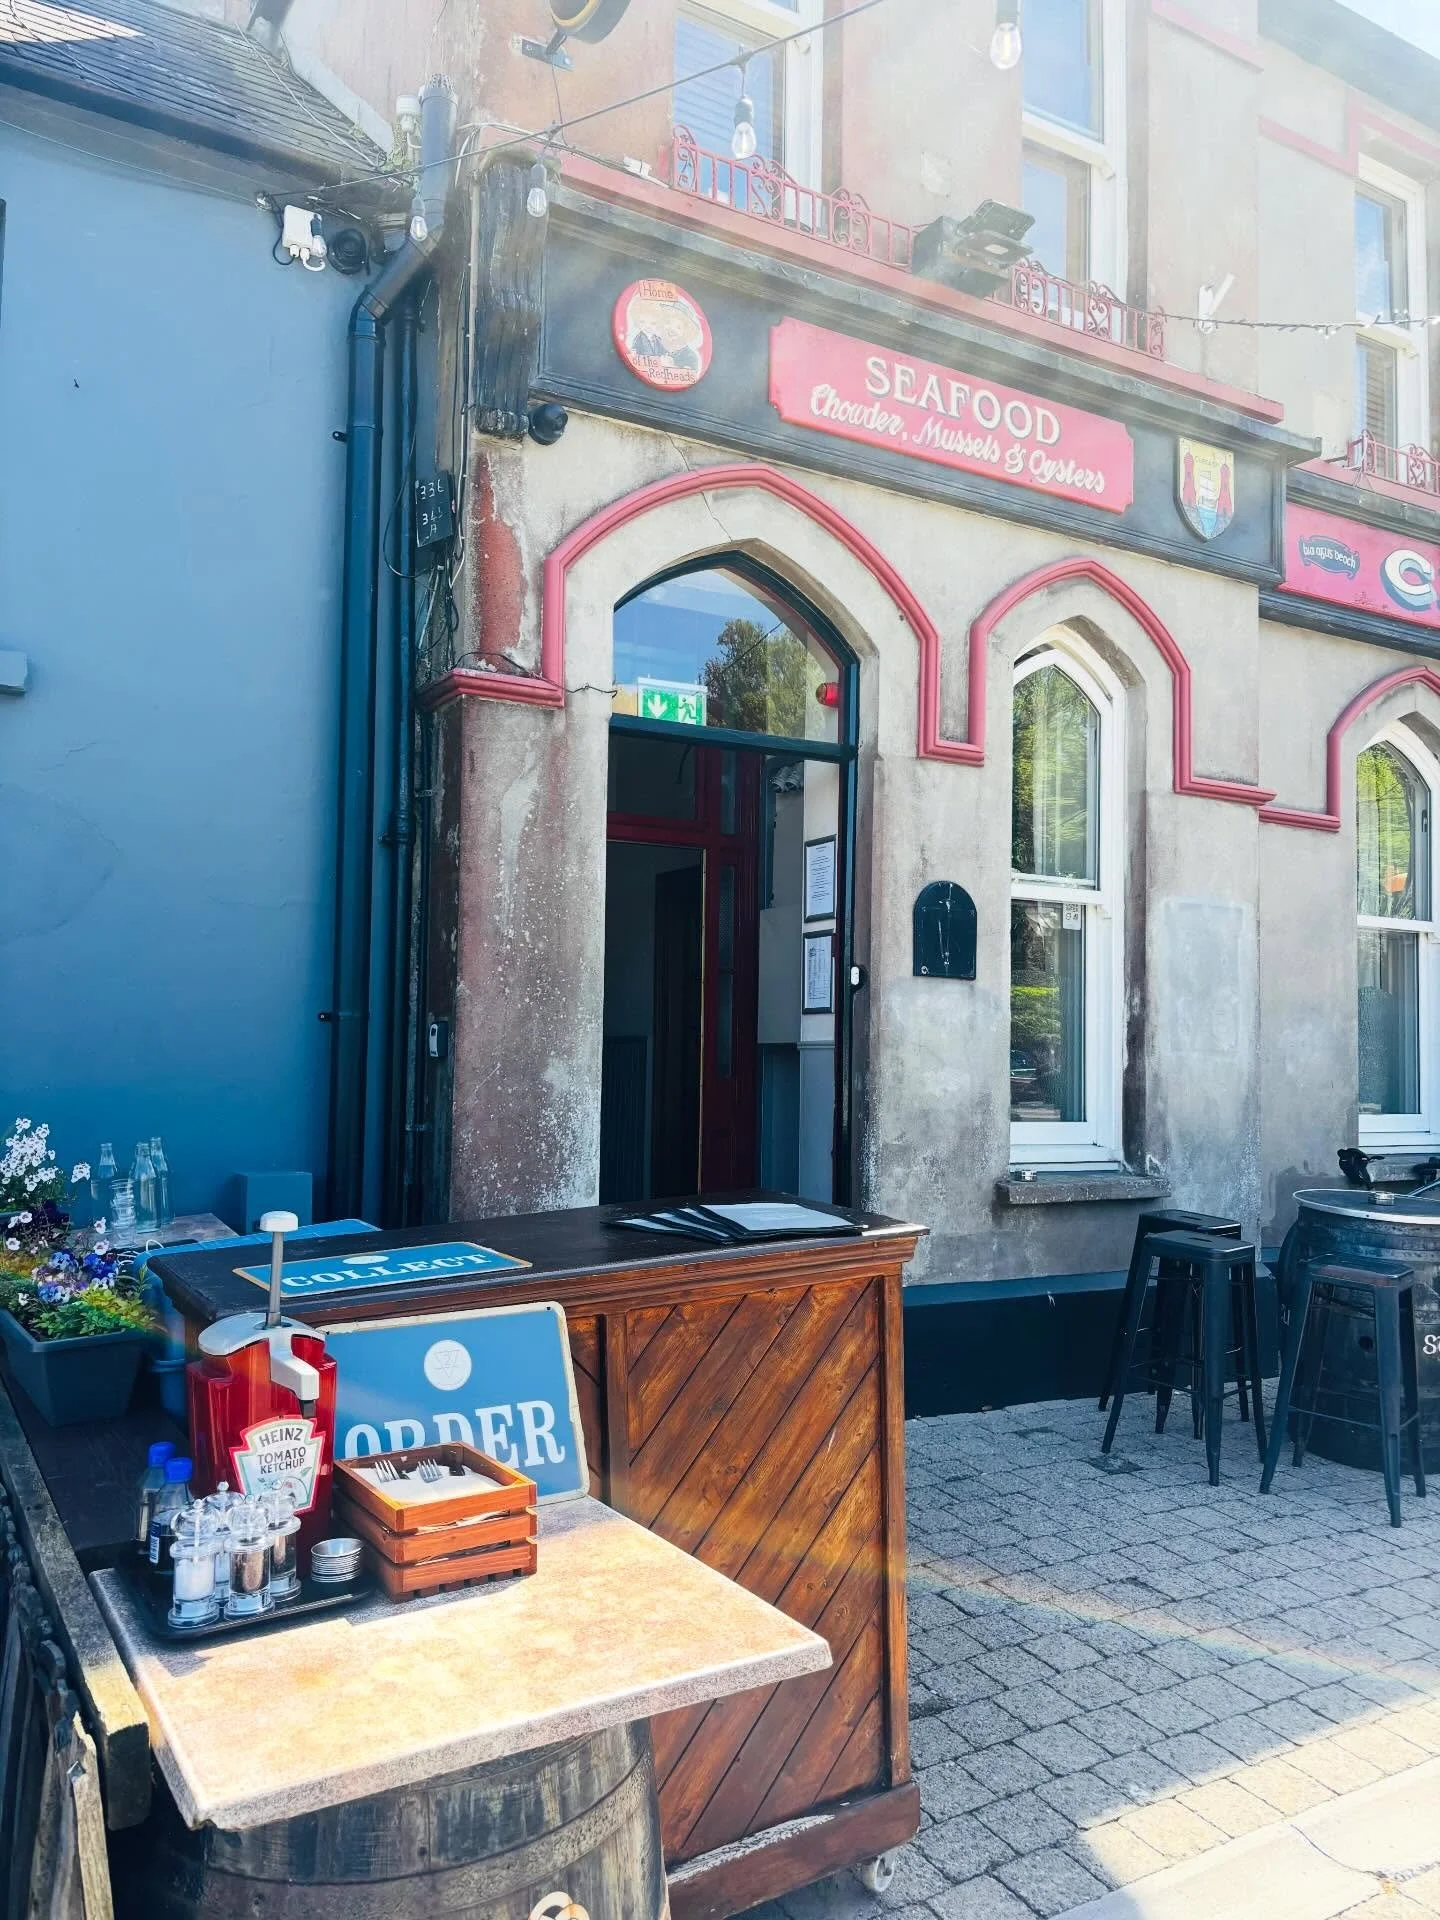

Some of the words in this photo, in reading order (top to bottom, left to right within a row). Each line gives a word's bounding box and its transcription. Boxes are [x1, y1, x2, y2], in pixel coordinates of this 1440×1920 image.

[642, 281, 674, 298] Home
[645, 356, 658, 367] the
[648, 367, 696, 383] Redheads
[865, 356, 1061, 445] SEAFOOD
[912, 416, 1001, 463] Mussels
[1004, 443, 1026, 474] &
[1029, 449, 1105, 494] Oysters
[281, 1254, 492, 1287] COLLECT
[259, 1427, 304, 1447] HEINZ
[257, 1446, 306, 1465] TOMATO
[260, 1458, 305, 1474] KETCHUP
